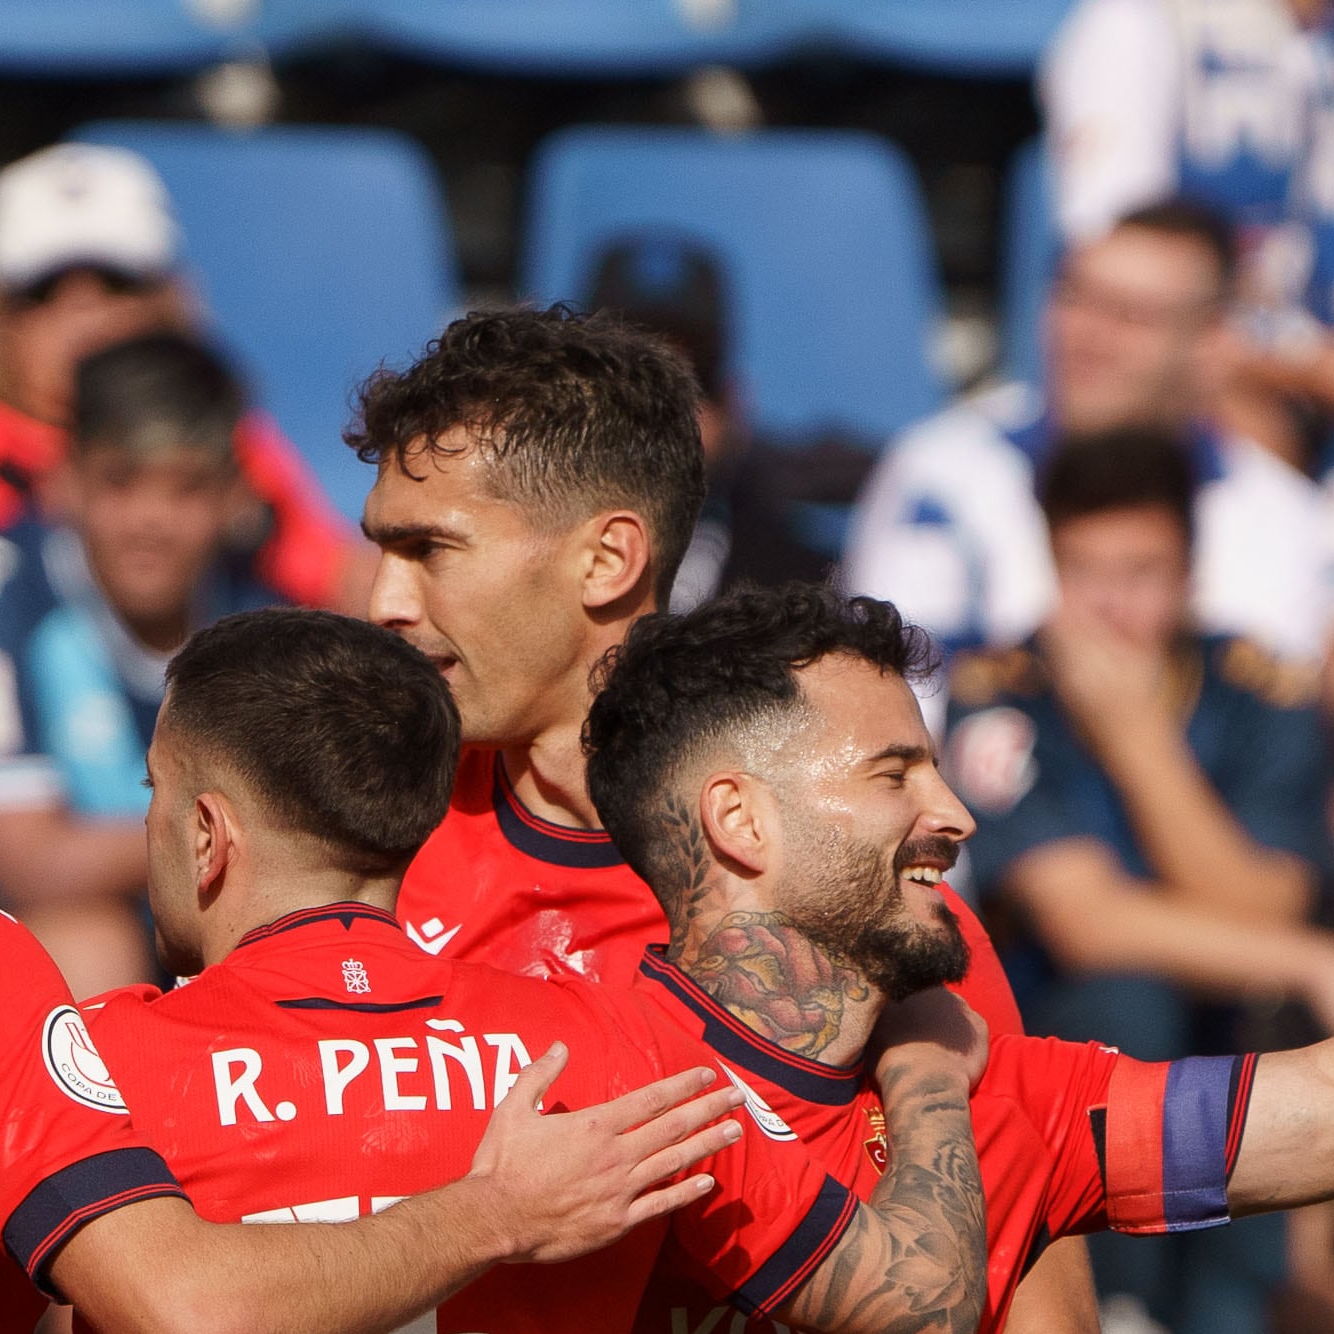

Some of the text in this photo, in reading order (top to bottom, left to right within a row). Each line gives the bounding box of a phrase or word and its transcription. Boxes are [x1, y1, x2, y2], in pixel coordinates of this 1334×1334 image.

[61, 1062, 93, 1096] COPA
[211, 1018, 544, 1126] R. PEÑA
